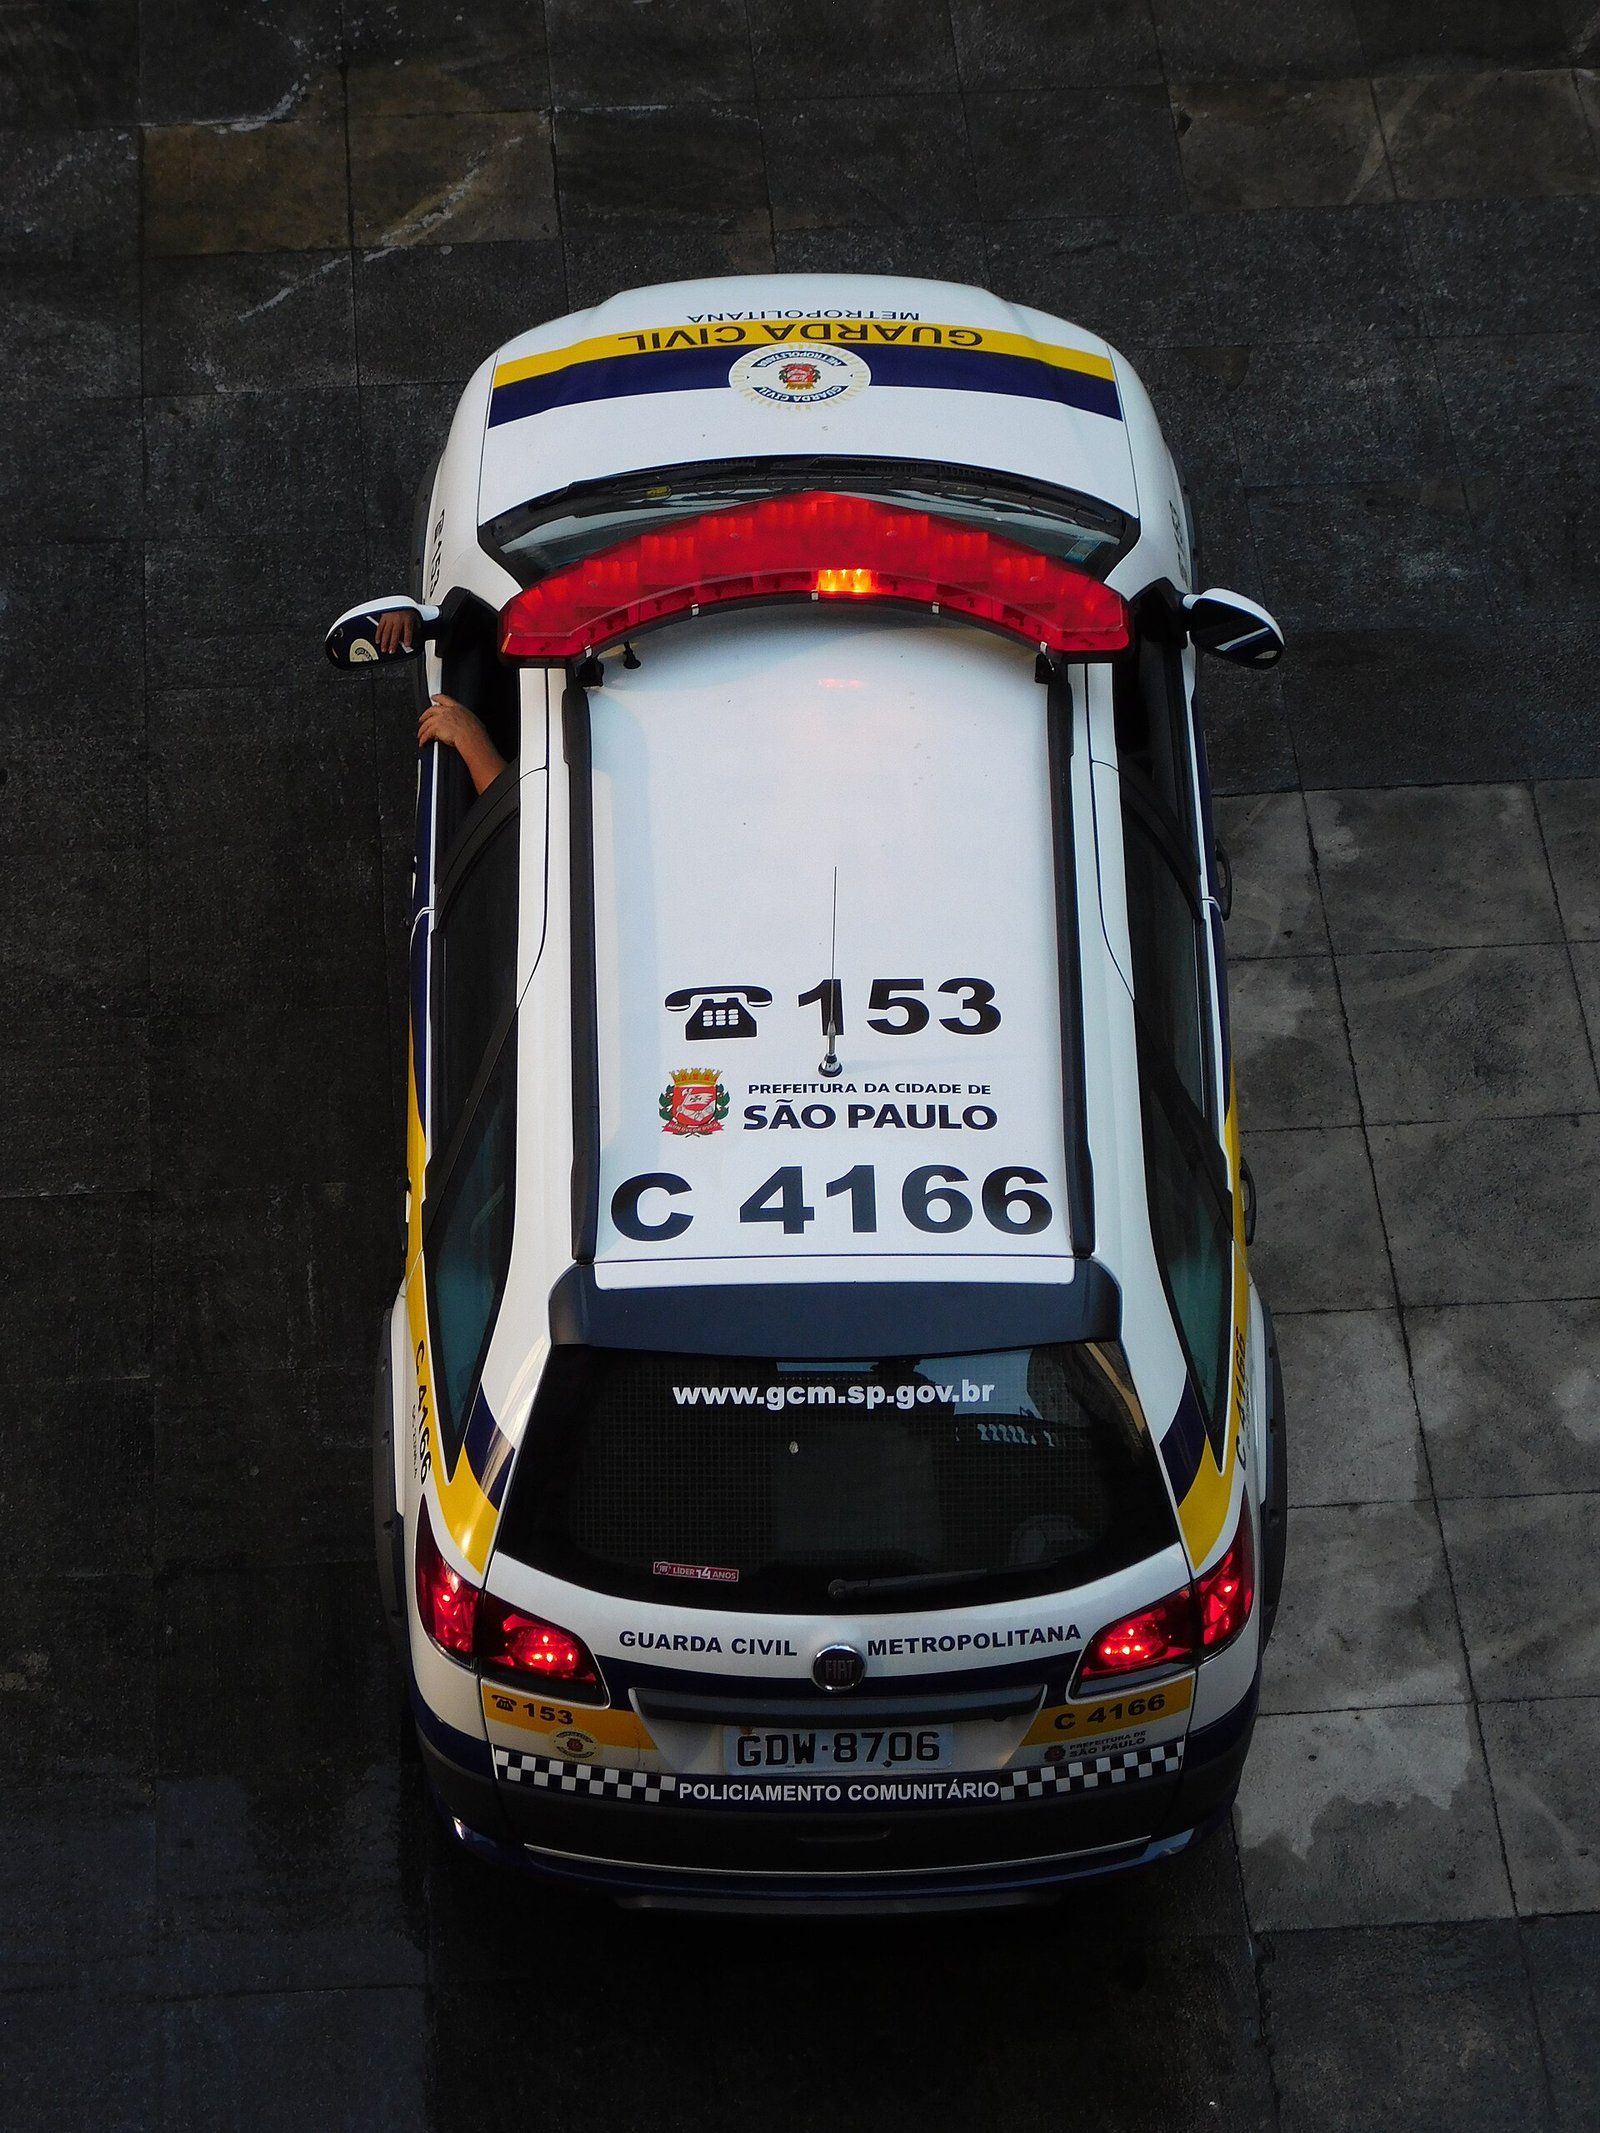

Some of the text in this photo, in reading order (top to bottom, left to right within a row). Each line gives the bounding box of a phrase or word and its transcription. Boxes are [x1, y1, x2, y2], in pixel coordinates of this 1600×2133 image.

[687, 310, 920, 323] METROPOLITANA
[618, 323, 983, 351] GUARDA CIVIL
[758, 386, 842, 402] GUARDA CIVIL
[797, 976, 1002, 1036] 153
[748, 1083, 991, 1095] PREFEITURA DA CIDADE DE
[743, 1098, 998, 1131] SÃO PAULO
[611, 1164, 1053, 1242] C 4166
[672, 1379, 996, 1411] www.gcm.sp.gov.br
[416, 1339, 432, 1485] C 4166
[1236, 1435, 1247, 1471] C
[696, 1567, 711, 1580] 14
[712, 1570, 736, 1580] ANOS
[619, 1624, 1081, 1657] GUARDA CIVIL METROPOLITANA
[825, 1659, 855, 1681] FIAT
[523, 1703, 574, 1725] 153
[1054, 1693, 1166, 1730] C 4166
[1102, 1737, 1146, 1752] PAULO
[679, 1779, 999, 1802] POLICIAMENTO COMUNITÁRIO
